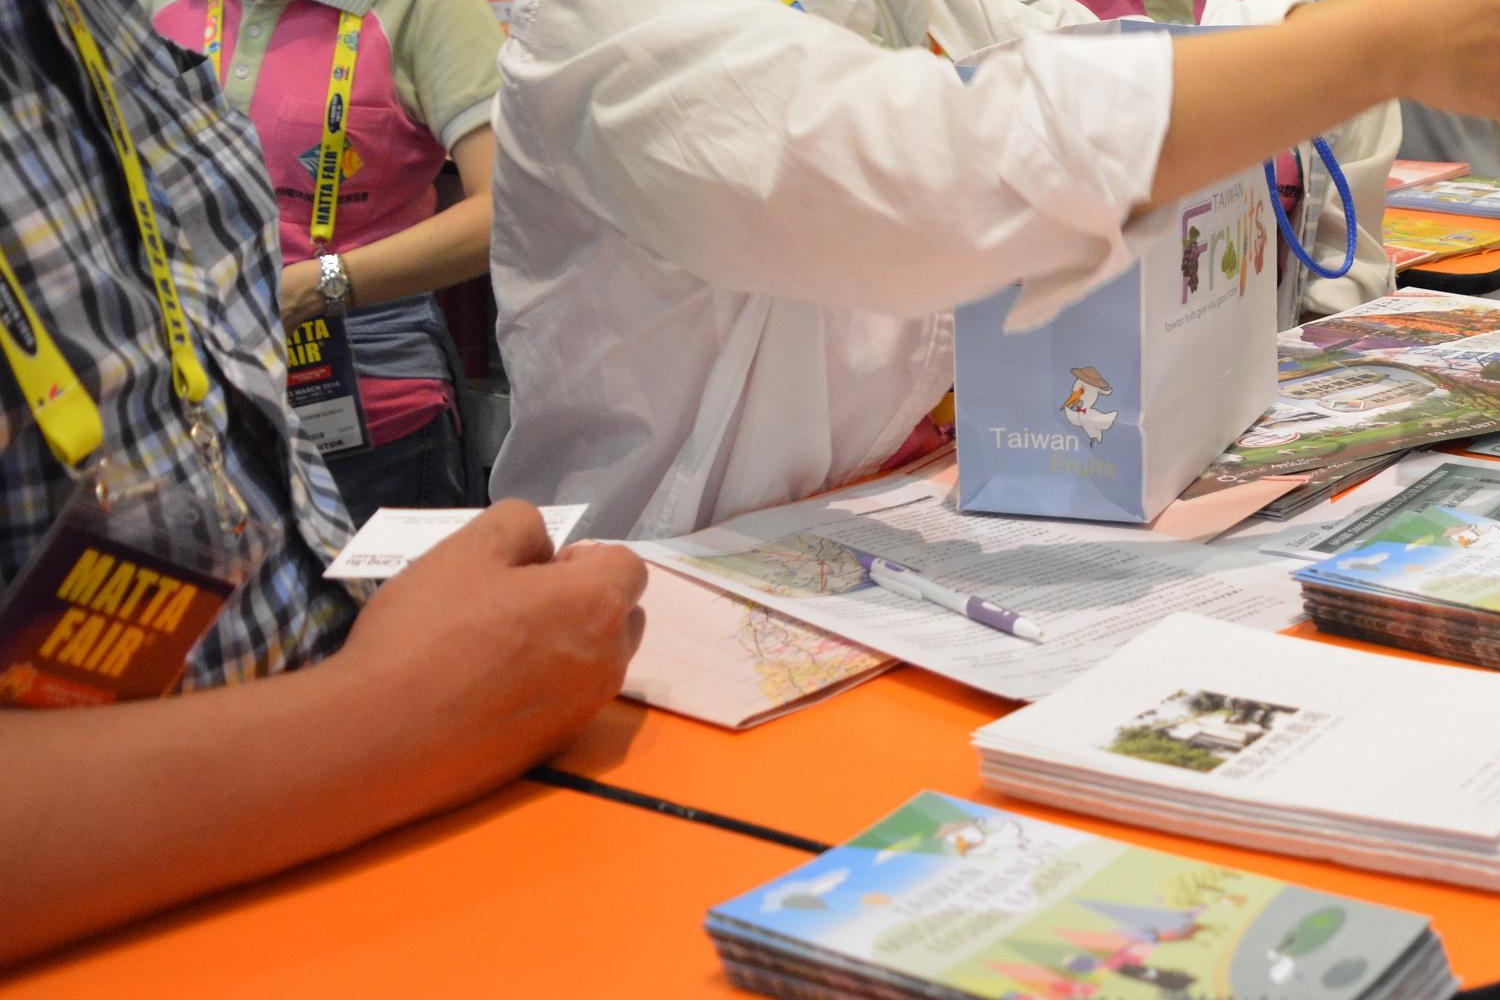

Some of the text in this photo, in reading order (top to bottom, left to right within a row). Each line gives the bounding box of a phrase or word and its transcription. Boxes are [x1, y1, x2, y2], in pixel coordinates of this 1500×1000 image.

[323, 149, 337, 176] FAIR
[316, 184, 335, 225] MATTA
[1212, 181, 1244, 212] TAIWAN
[1181, 184, 1267, 305] Fruits
[288, 342, 322, 367] AIR
[988, 427, 1079, 451] Taiwan
[1051, 455, 1117, 479] Fruits
[55, 547, 199, 634] MATTA
[39, 606, 148, 679] FAIR
